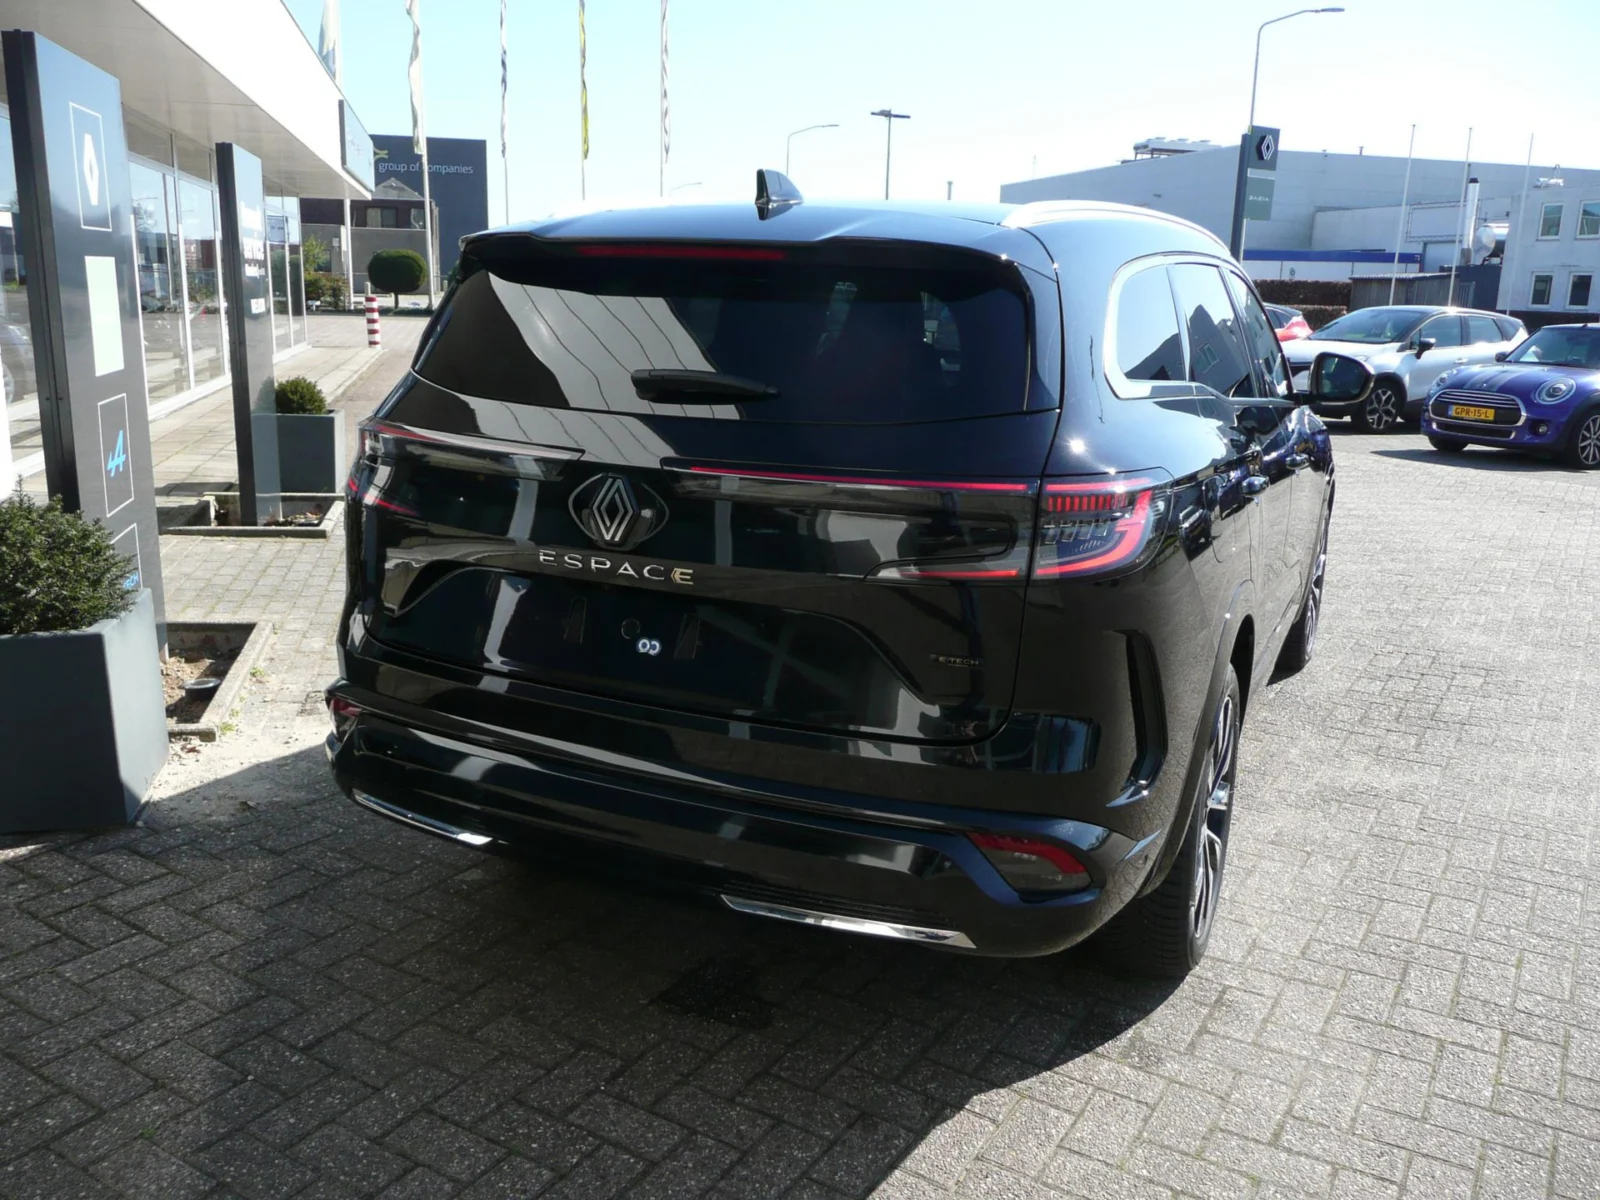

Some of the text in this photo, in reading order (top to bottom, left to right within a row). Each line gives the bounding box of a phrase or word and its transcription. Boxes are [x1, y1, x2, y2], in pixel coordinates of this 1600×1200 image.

[378, 161, 474, 175] group of ompanies
[1454, 406, 1490, 419] GPR-15-L
[538, 549, 694, 585] ESPACE
